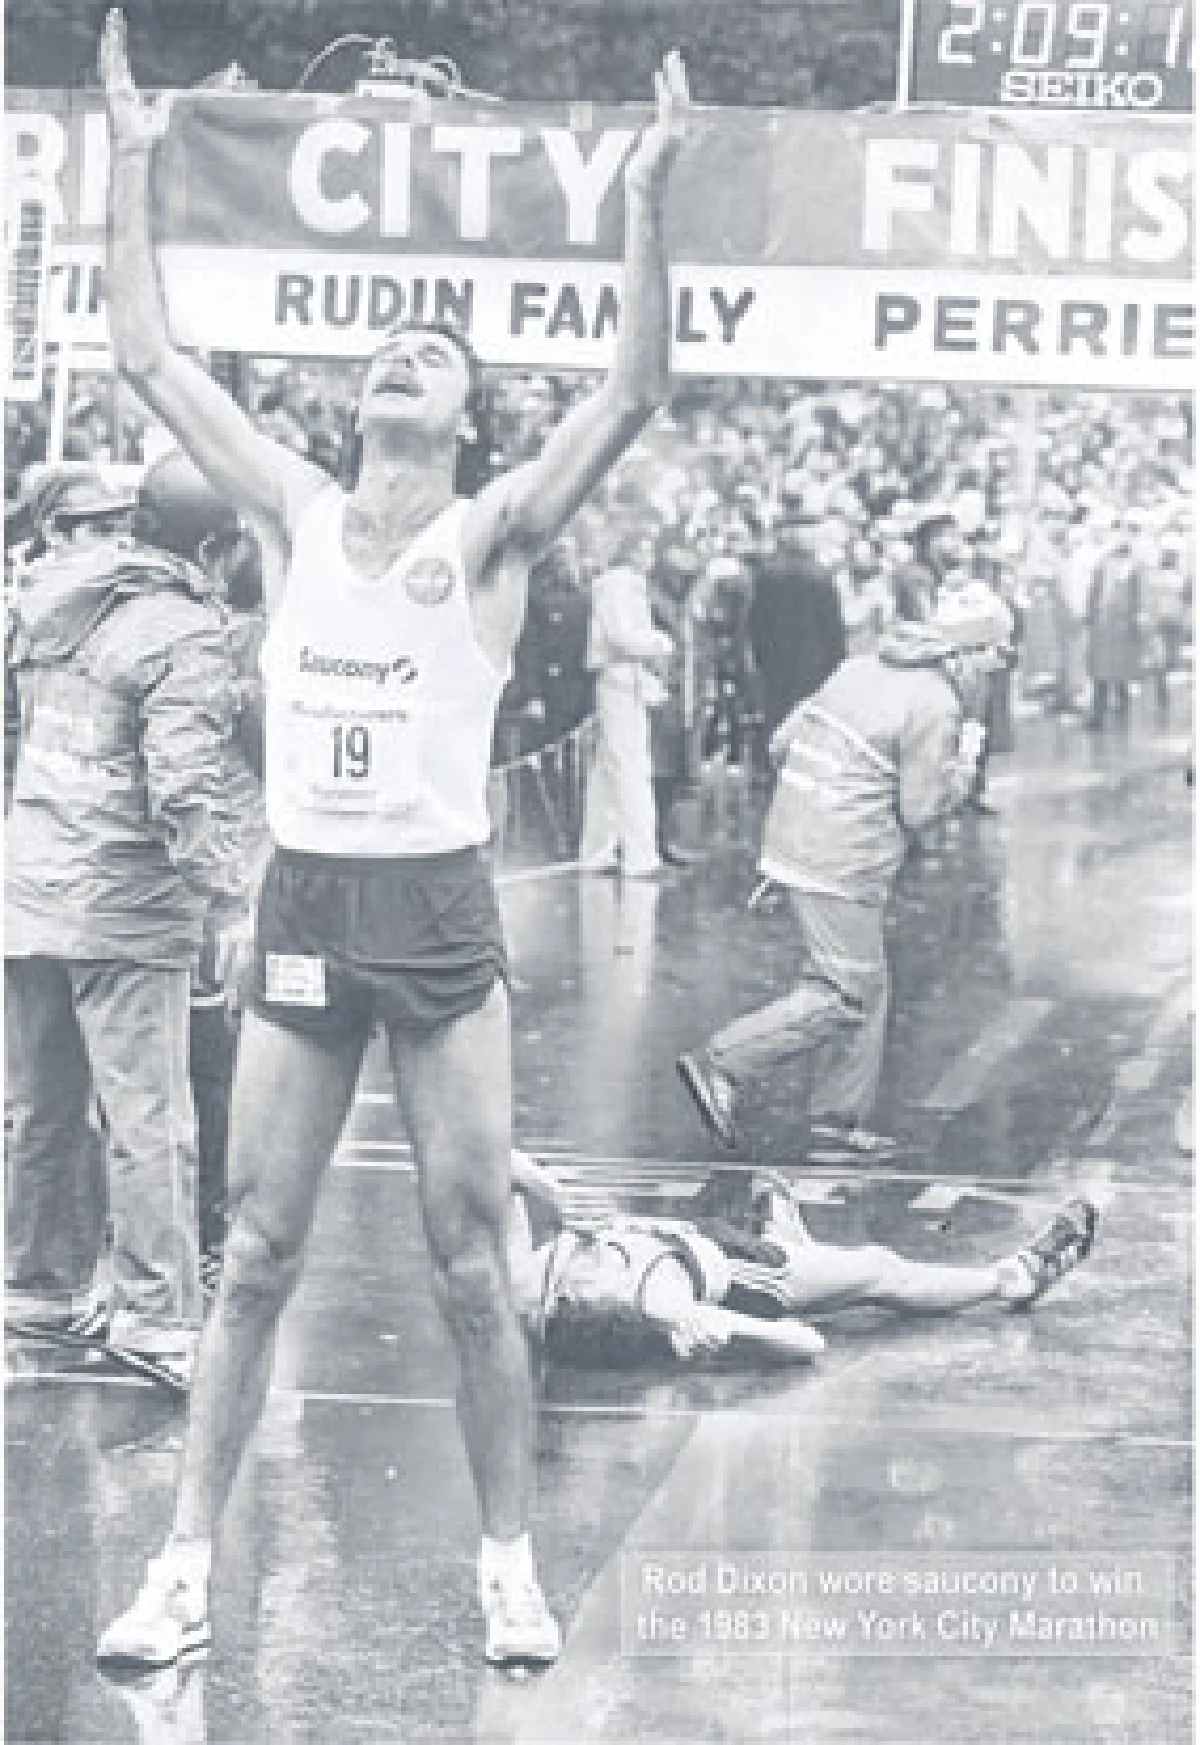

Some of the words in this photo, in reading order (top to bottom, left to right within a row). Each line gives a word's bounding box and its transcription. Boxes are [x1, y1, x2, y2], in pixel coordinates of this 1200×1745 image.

[937, 0, 1195, 69] 2:09:1
[1000, 71, 1163, 107] SEIKO
[292, 118, 634, 245] CITY
[861, 137, 1193, 262] FINIS
[274, 273, 474, 333] RUDIN
[510, 278, 756, 343] FALY
[874, 292, 1194, 360] PERRIE
[331, 726, 371, 780] 19
